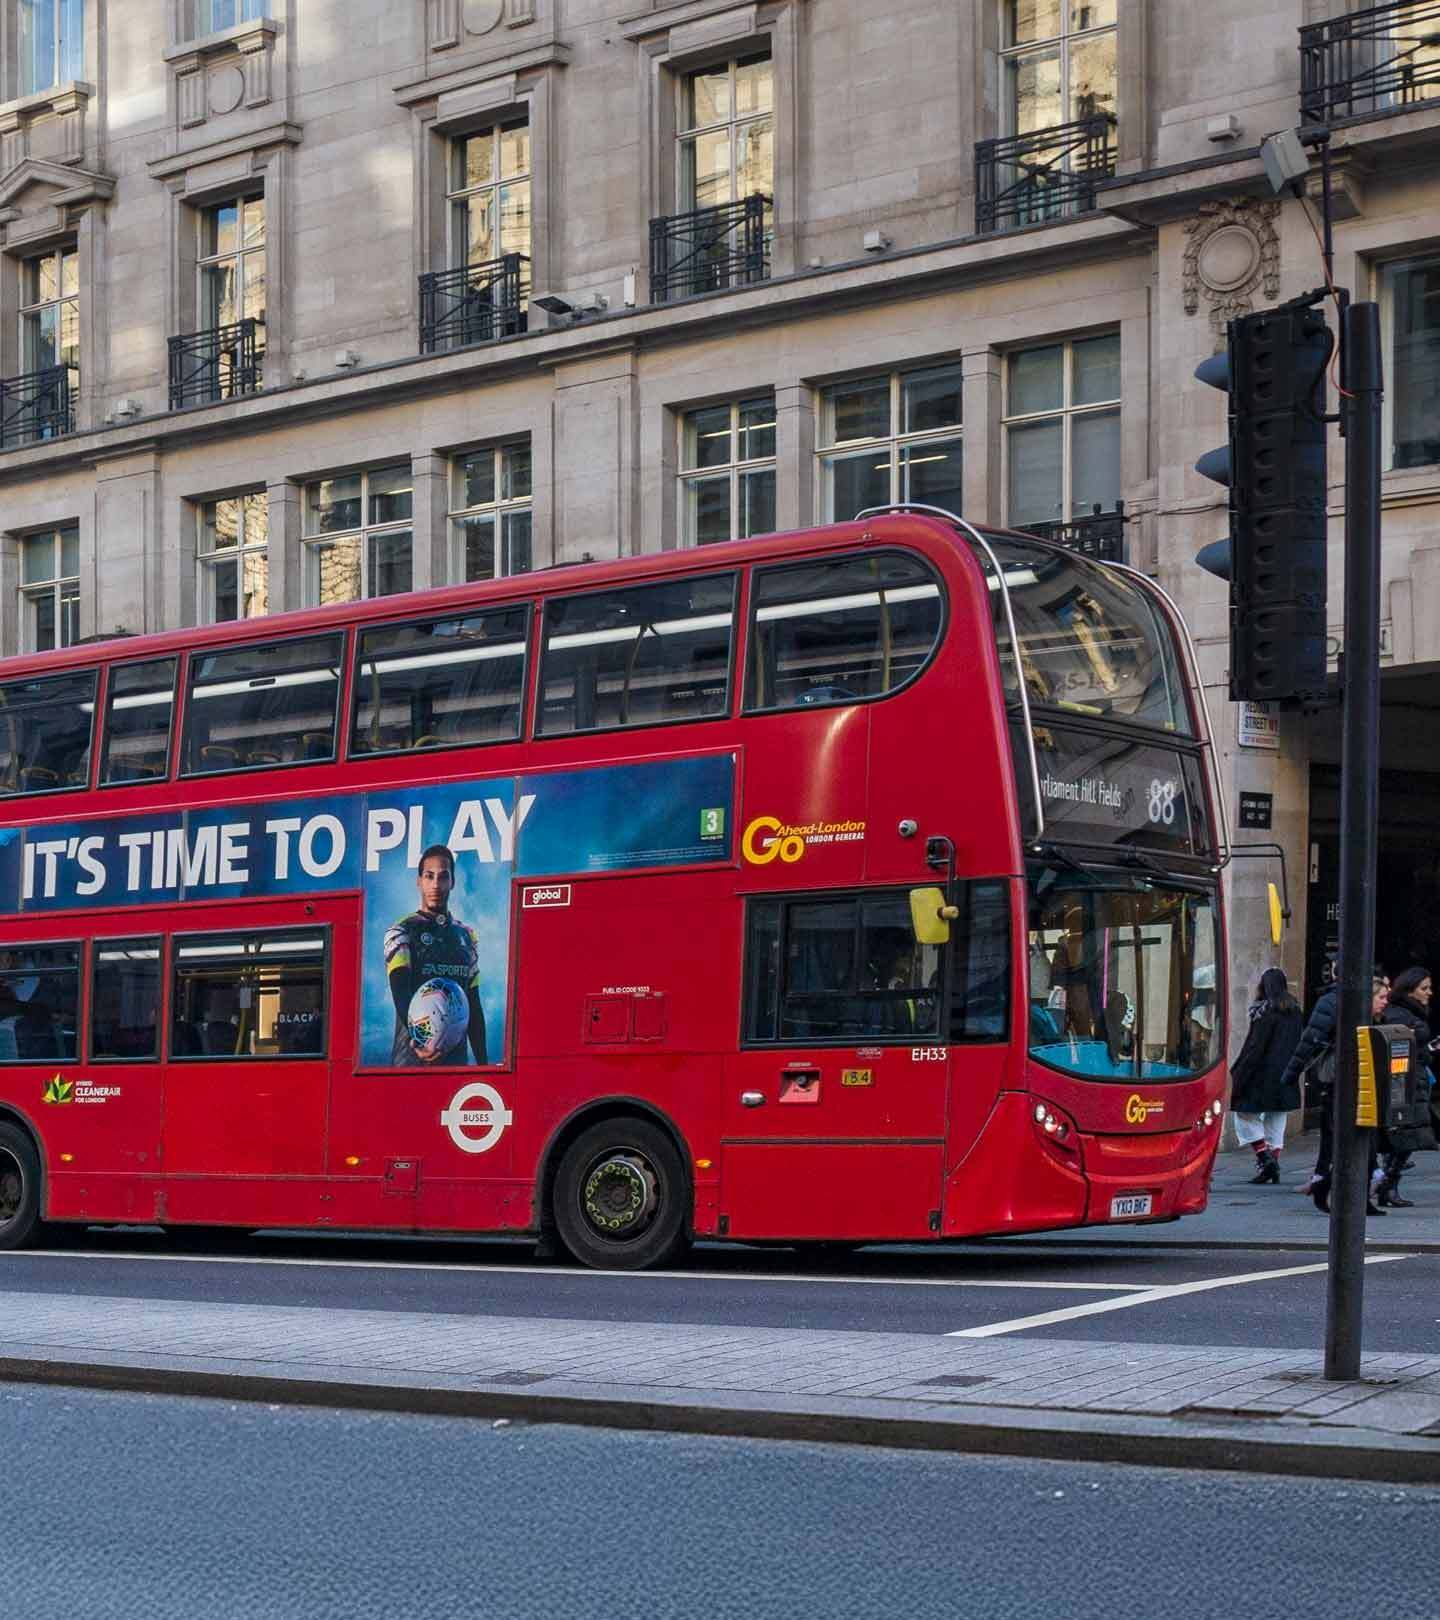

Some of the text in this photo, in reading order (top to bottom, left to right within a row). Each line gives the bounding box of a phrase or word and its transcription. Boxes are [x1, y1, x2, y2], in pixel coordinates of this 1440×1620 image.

[1081, 777, 1096, 803] Hill
[1098, 780, 1122, 807] Fields
[1148, 778, 1176, 824] 88
[706, 810, 718, 833] 3
[23, 794, 537, 899] IT'S TIME TO PLAY
[742, 816, 805, 865] Go
[806, 832, 865, 844] LONDON GENERAL
[532, 888, 561, 904] global
[911, 1047, 948, 1062] EH33
[463, 1113, 490, 1122] BUSES
